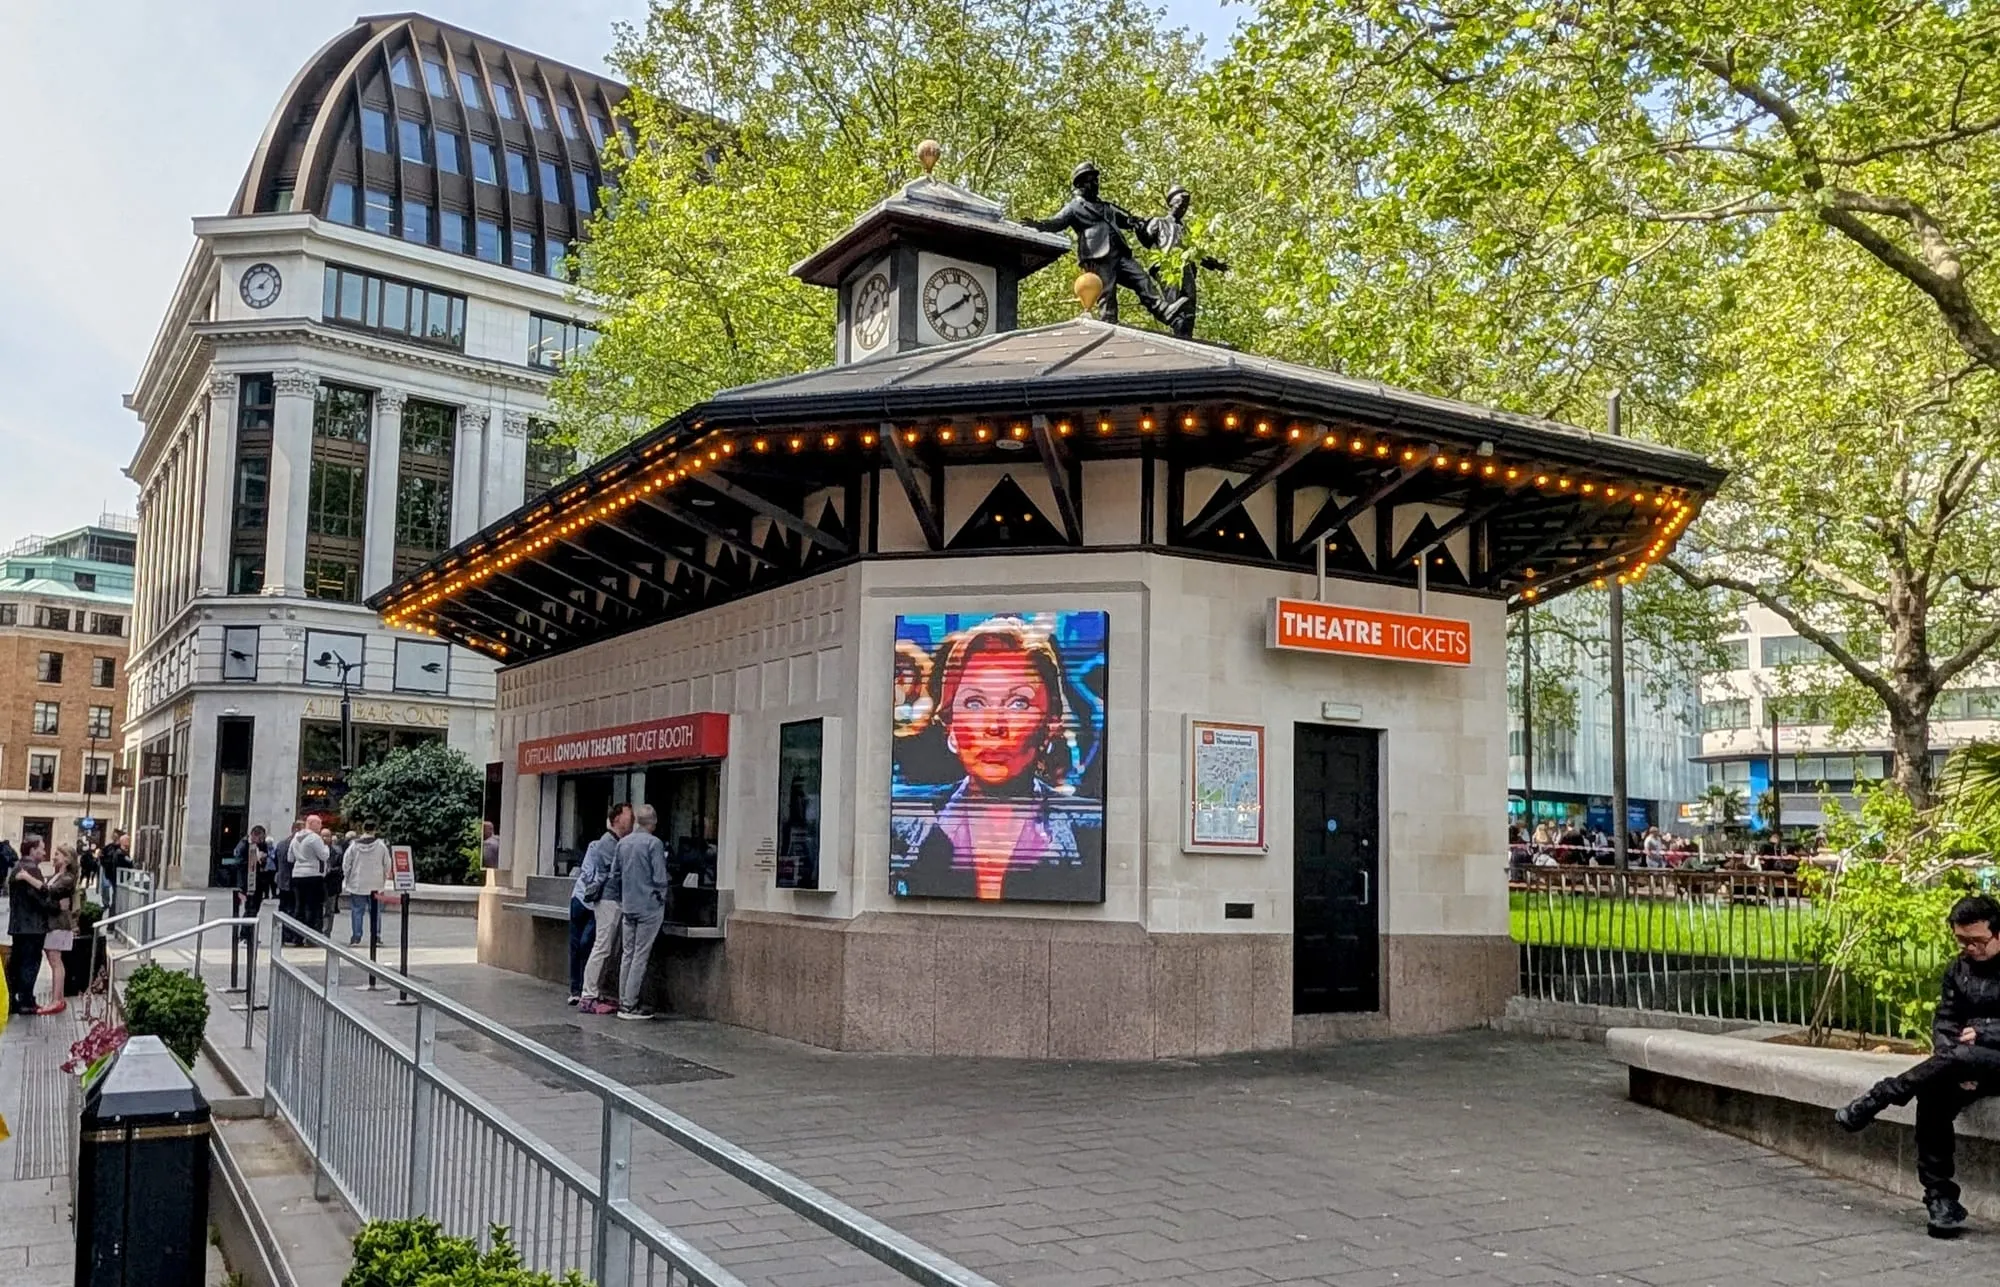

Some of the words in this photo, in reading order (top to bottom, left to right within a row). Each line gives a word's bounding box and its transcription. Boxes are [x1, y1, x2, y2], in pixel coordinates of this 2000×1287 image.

[1282, 611, 1383, 646] THEATRE
[1390, 623, 1467, 655] TICKETS
[524, 747, 553, 767] OFFICIAL
[553, 740, 590, 762] LONDON
[591, 734, 628, 758] THEATRE
[629, 730, 658, 752] TICKET
[658, 724, 693, 749] BOOTH
